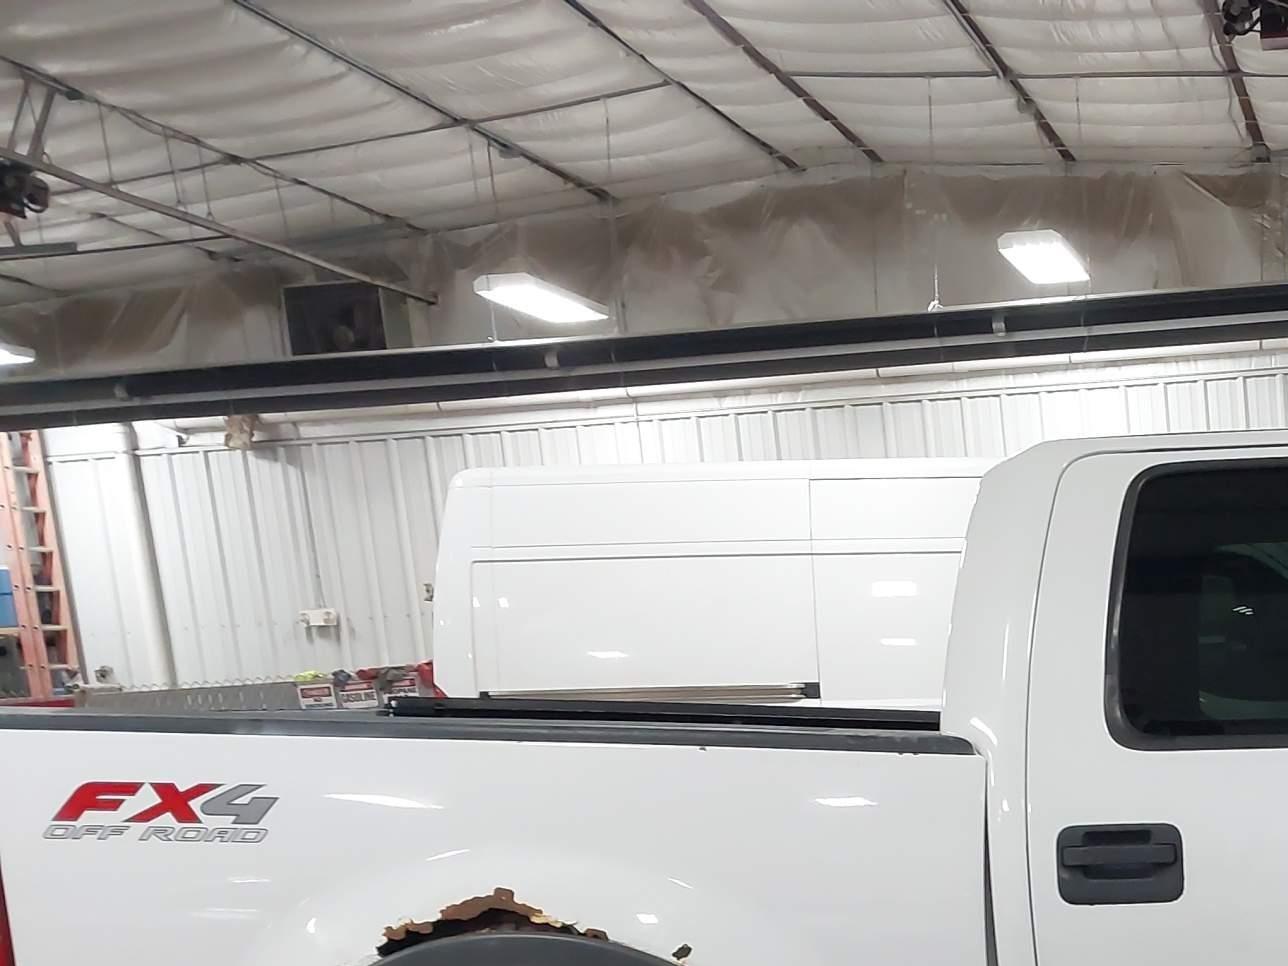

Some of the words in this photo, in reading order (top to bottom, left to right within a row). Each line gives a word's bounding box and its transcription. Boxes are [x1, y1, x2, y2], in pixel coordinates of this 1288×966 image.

[51, 781, 280, 825] FX4
[42, 824, 131, 841] OFF
[138, 825, 269, 844] ROAD
